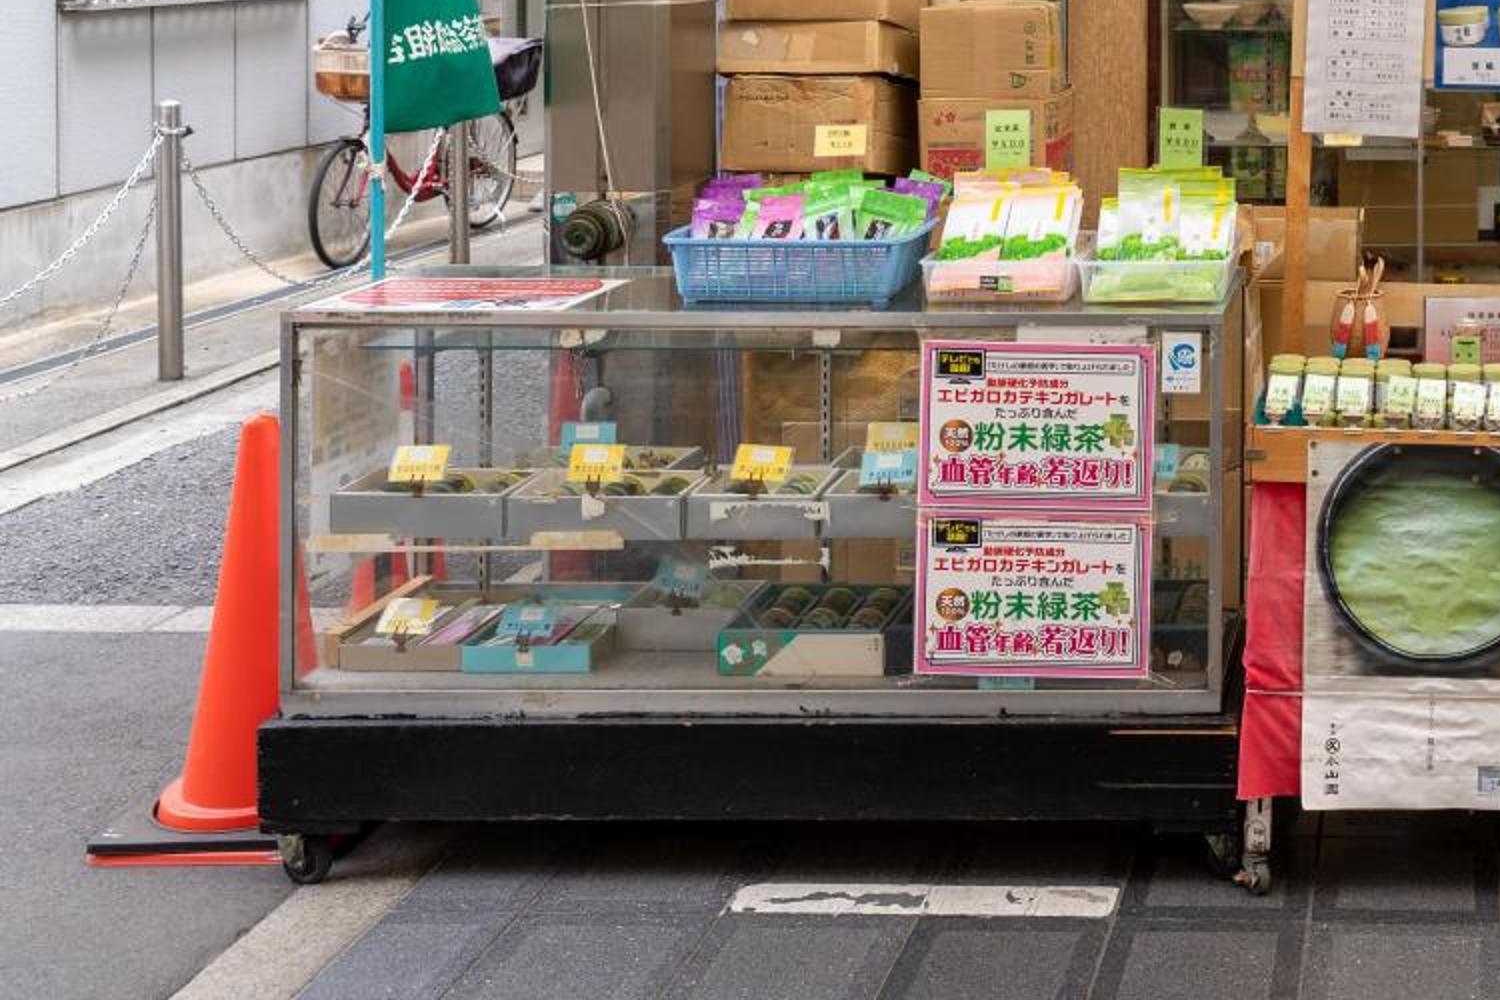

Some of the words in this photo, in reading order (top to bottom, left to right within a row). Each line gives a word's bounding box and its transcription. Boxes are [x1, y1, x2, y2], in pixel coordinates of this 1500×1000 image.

[994, 407, 1078, 419] たっぷり含んだ
[973, 421, 1105, 453] 粉末緑茶
[991, 576, 1075, 588] たっぷり含んだ
[971, 590, 1101, 621] 粉末緑茶
